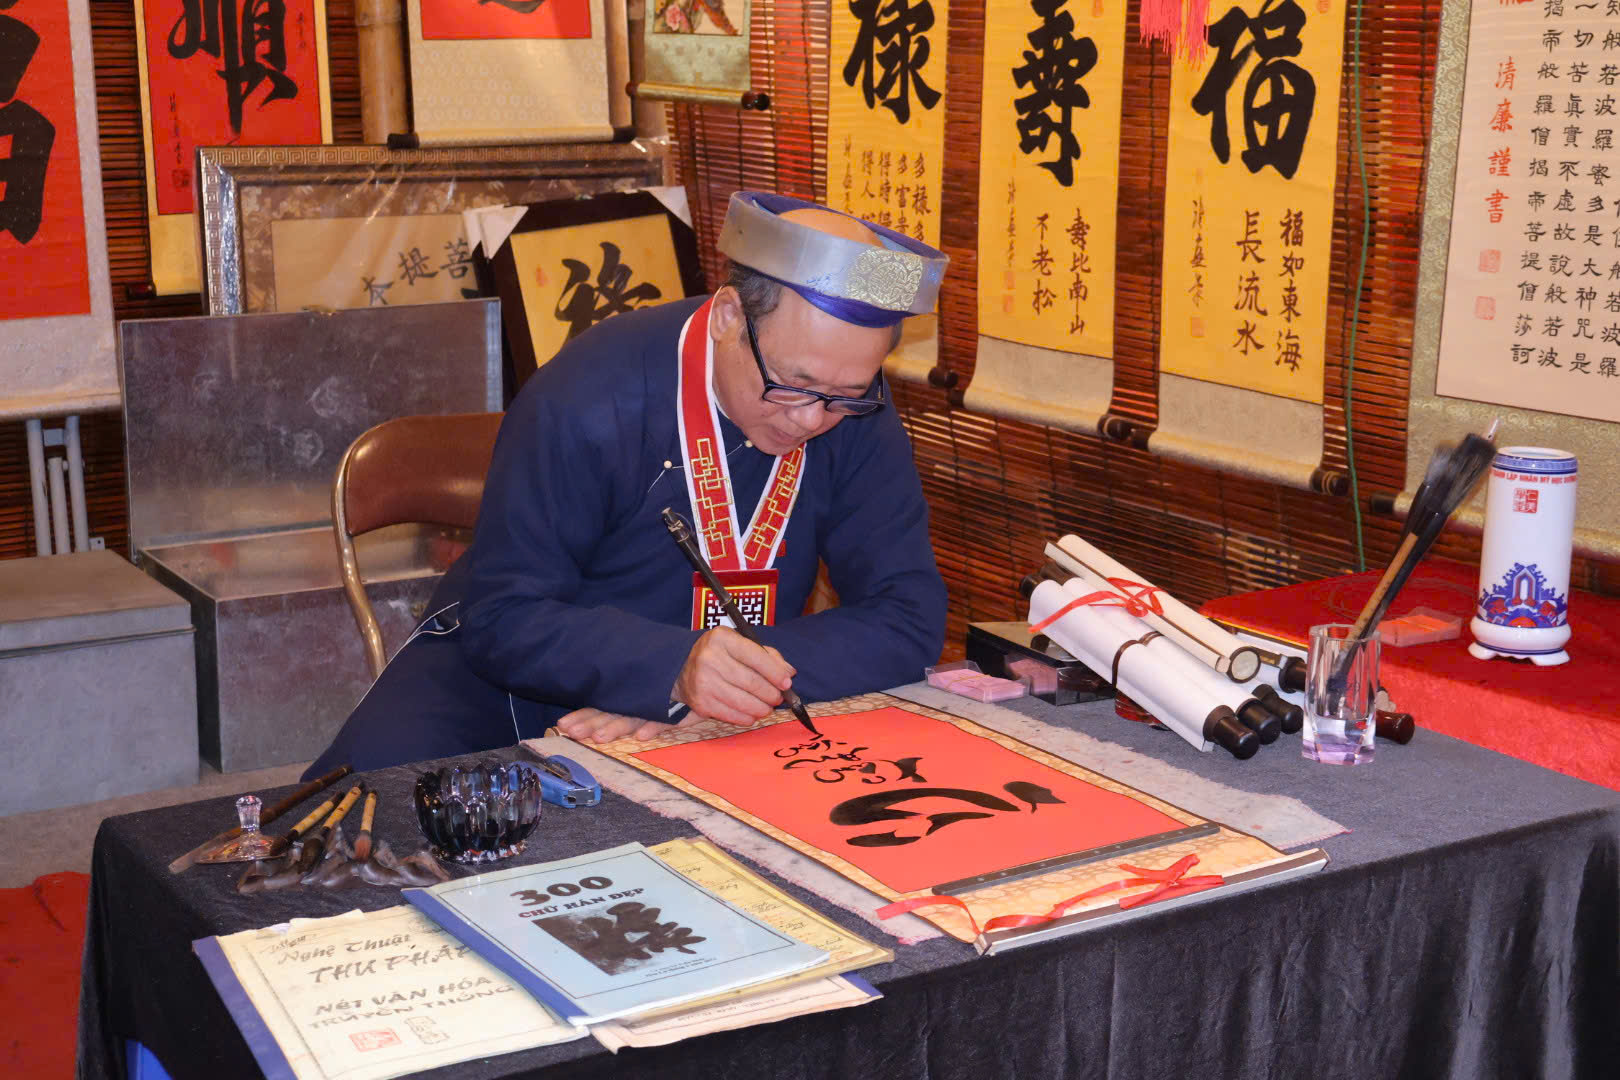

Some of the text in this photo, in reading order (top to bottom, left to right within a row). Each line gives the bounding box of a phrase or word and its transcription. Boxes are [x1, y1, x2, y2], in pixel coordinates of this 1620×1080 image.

[1032, 213, 1057, 316] 不老松
[1065, 207, 1092, 335] 壽比南山
[1232, 210, 1269, 357] 長流水
[1274, 208, 1304, 373] 福如東海
[510, 876, 613, 906] 300
[518, 902, 557, 918] CHỮ
[609, 887, 645, 900] ĐẸP
